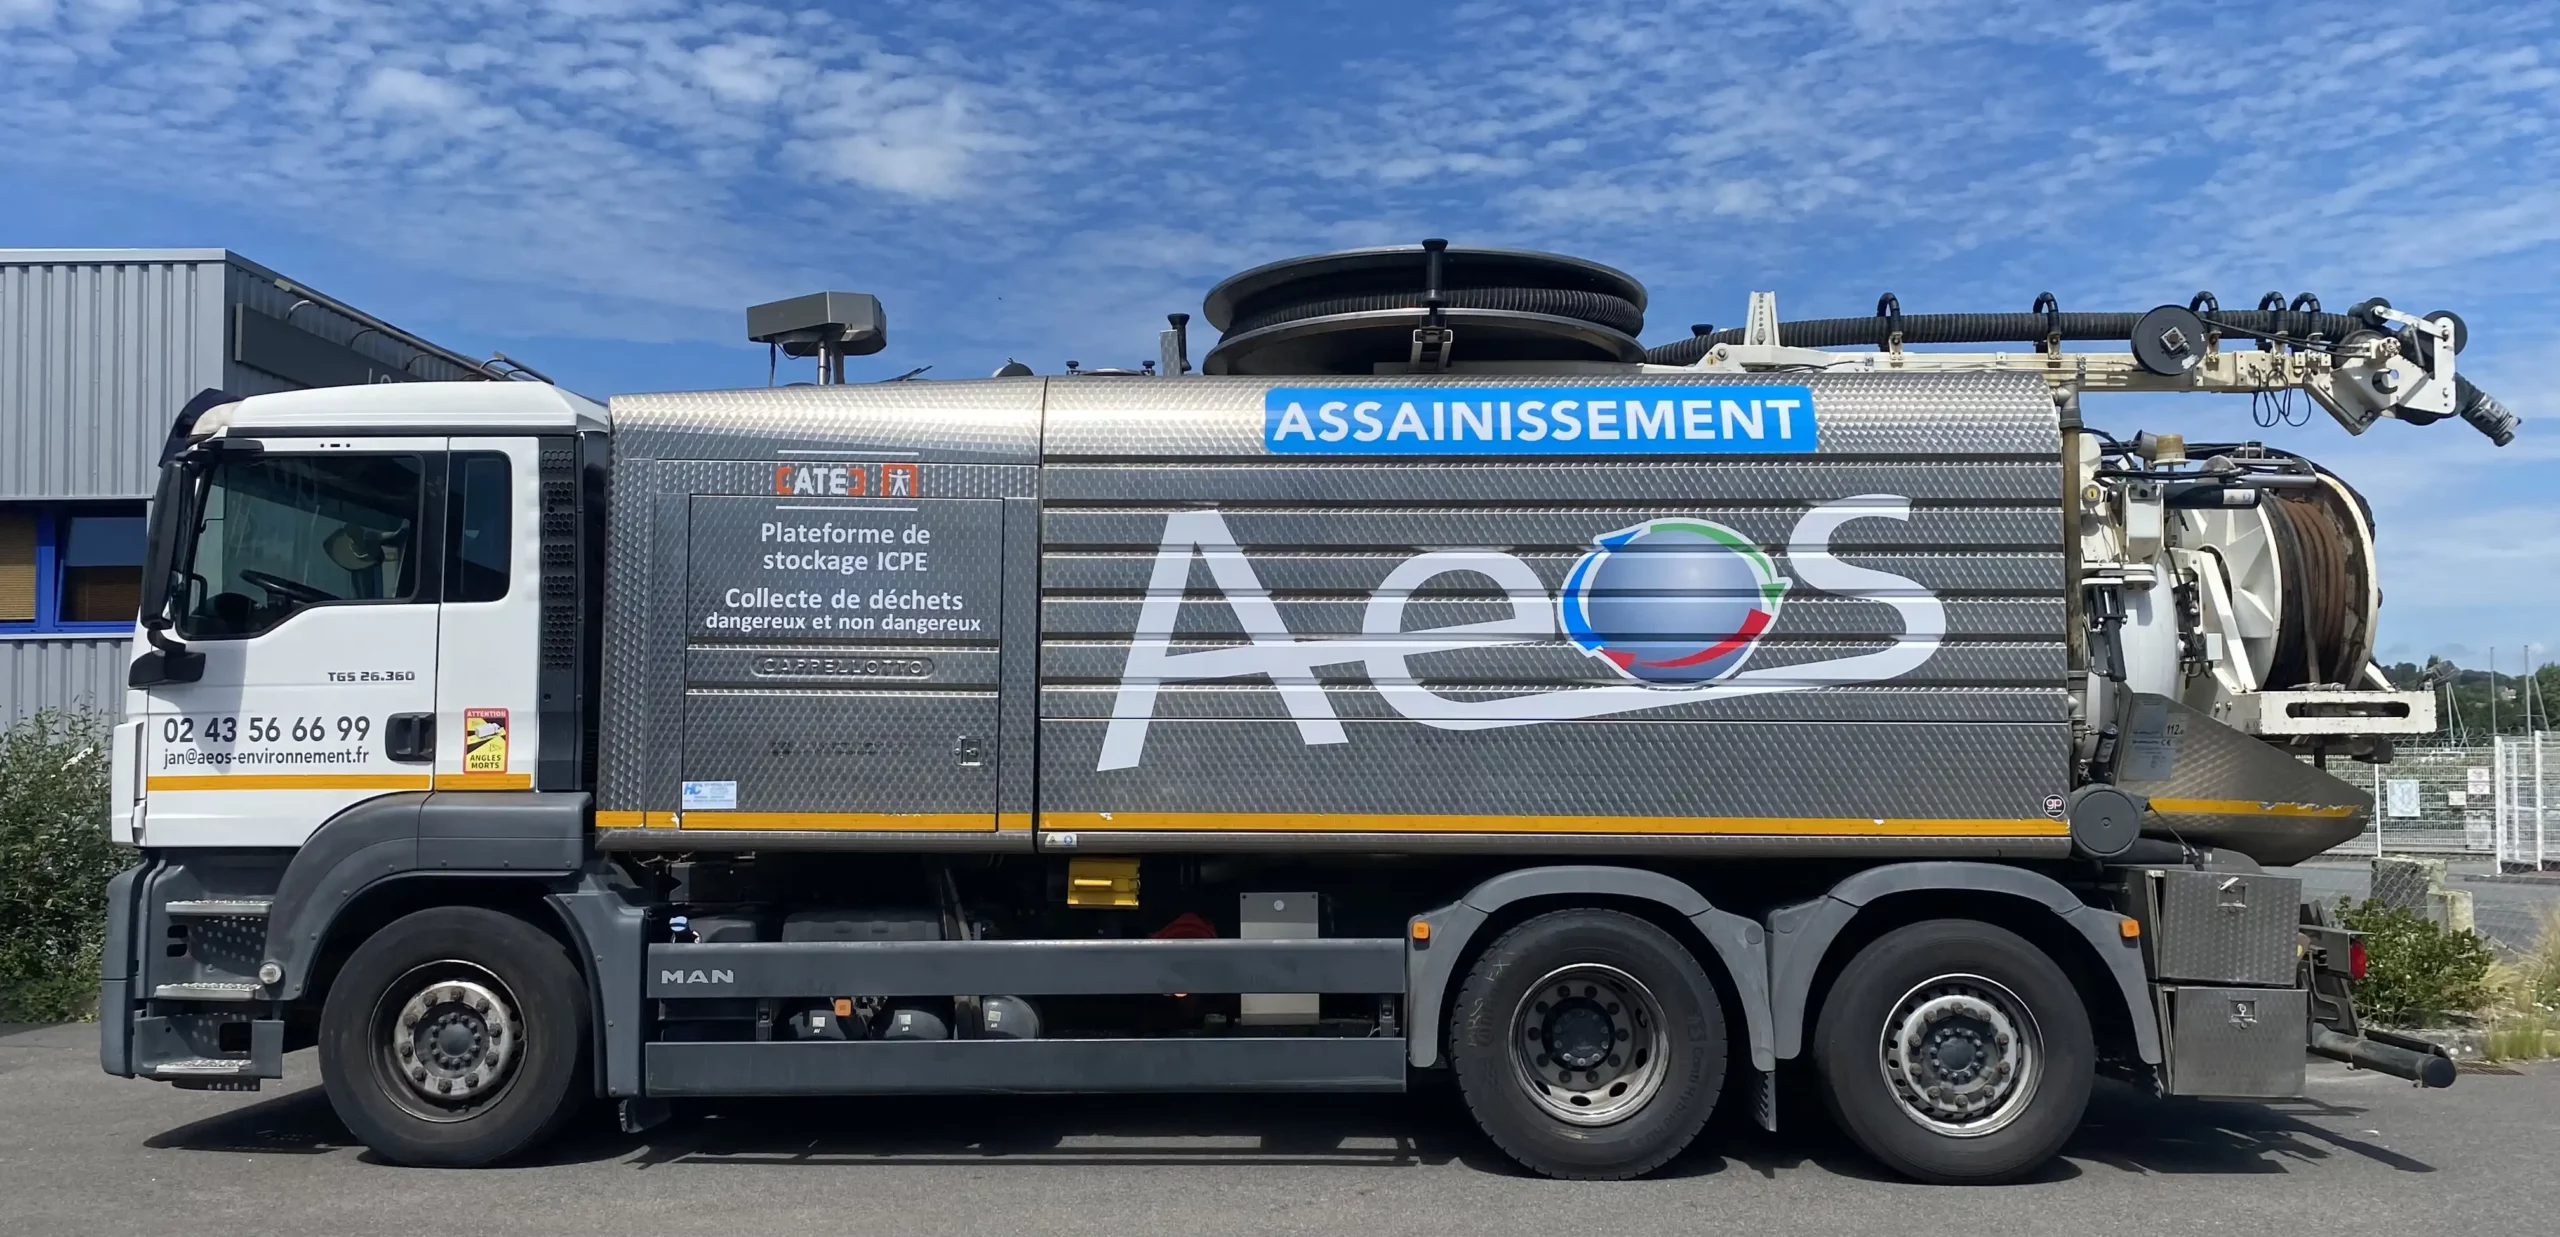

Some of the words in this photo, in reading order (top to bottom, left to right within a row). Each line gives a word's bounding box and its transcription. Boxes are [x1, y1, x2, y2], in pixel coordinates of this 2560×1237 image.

[1273, 399, 1801, 441] ASSAINISSEMENT
[761, 522, 895, 544] Plateforme
[902, 524, 931, 544] de
[763, 550, 869, 575] stockage
[878, 551, 928, 571] ICPE
[725, 588, 823, 609] Collecte
[831, 589, 861, 610] de
[869, 589, 964, 610] déchets
[706, 612, 806, 632] dangereux
[812, 615, 832, 630] et
[838, 616, 875, 630] non
[881, 614, 981, 633] dangereux
[1096, 492, 1946, 771] Aeos
[327, 672, 356, 681] TGS
[360, 671, 415, 681] 26.360
[762, 657, 924, 674] CAPPELLOTTO
[163, 718, 194, 743] 02
[204, 717, 237, 743] 43
[248, 717, 281, 742] 56
[292, 716, 325, 742] 66
[337, 716, 370, 741] 99
[163, 746, 370, 770] jan@aeos-environnement.fr
[661, 969, 734, 984] MAN
